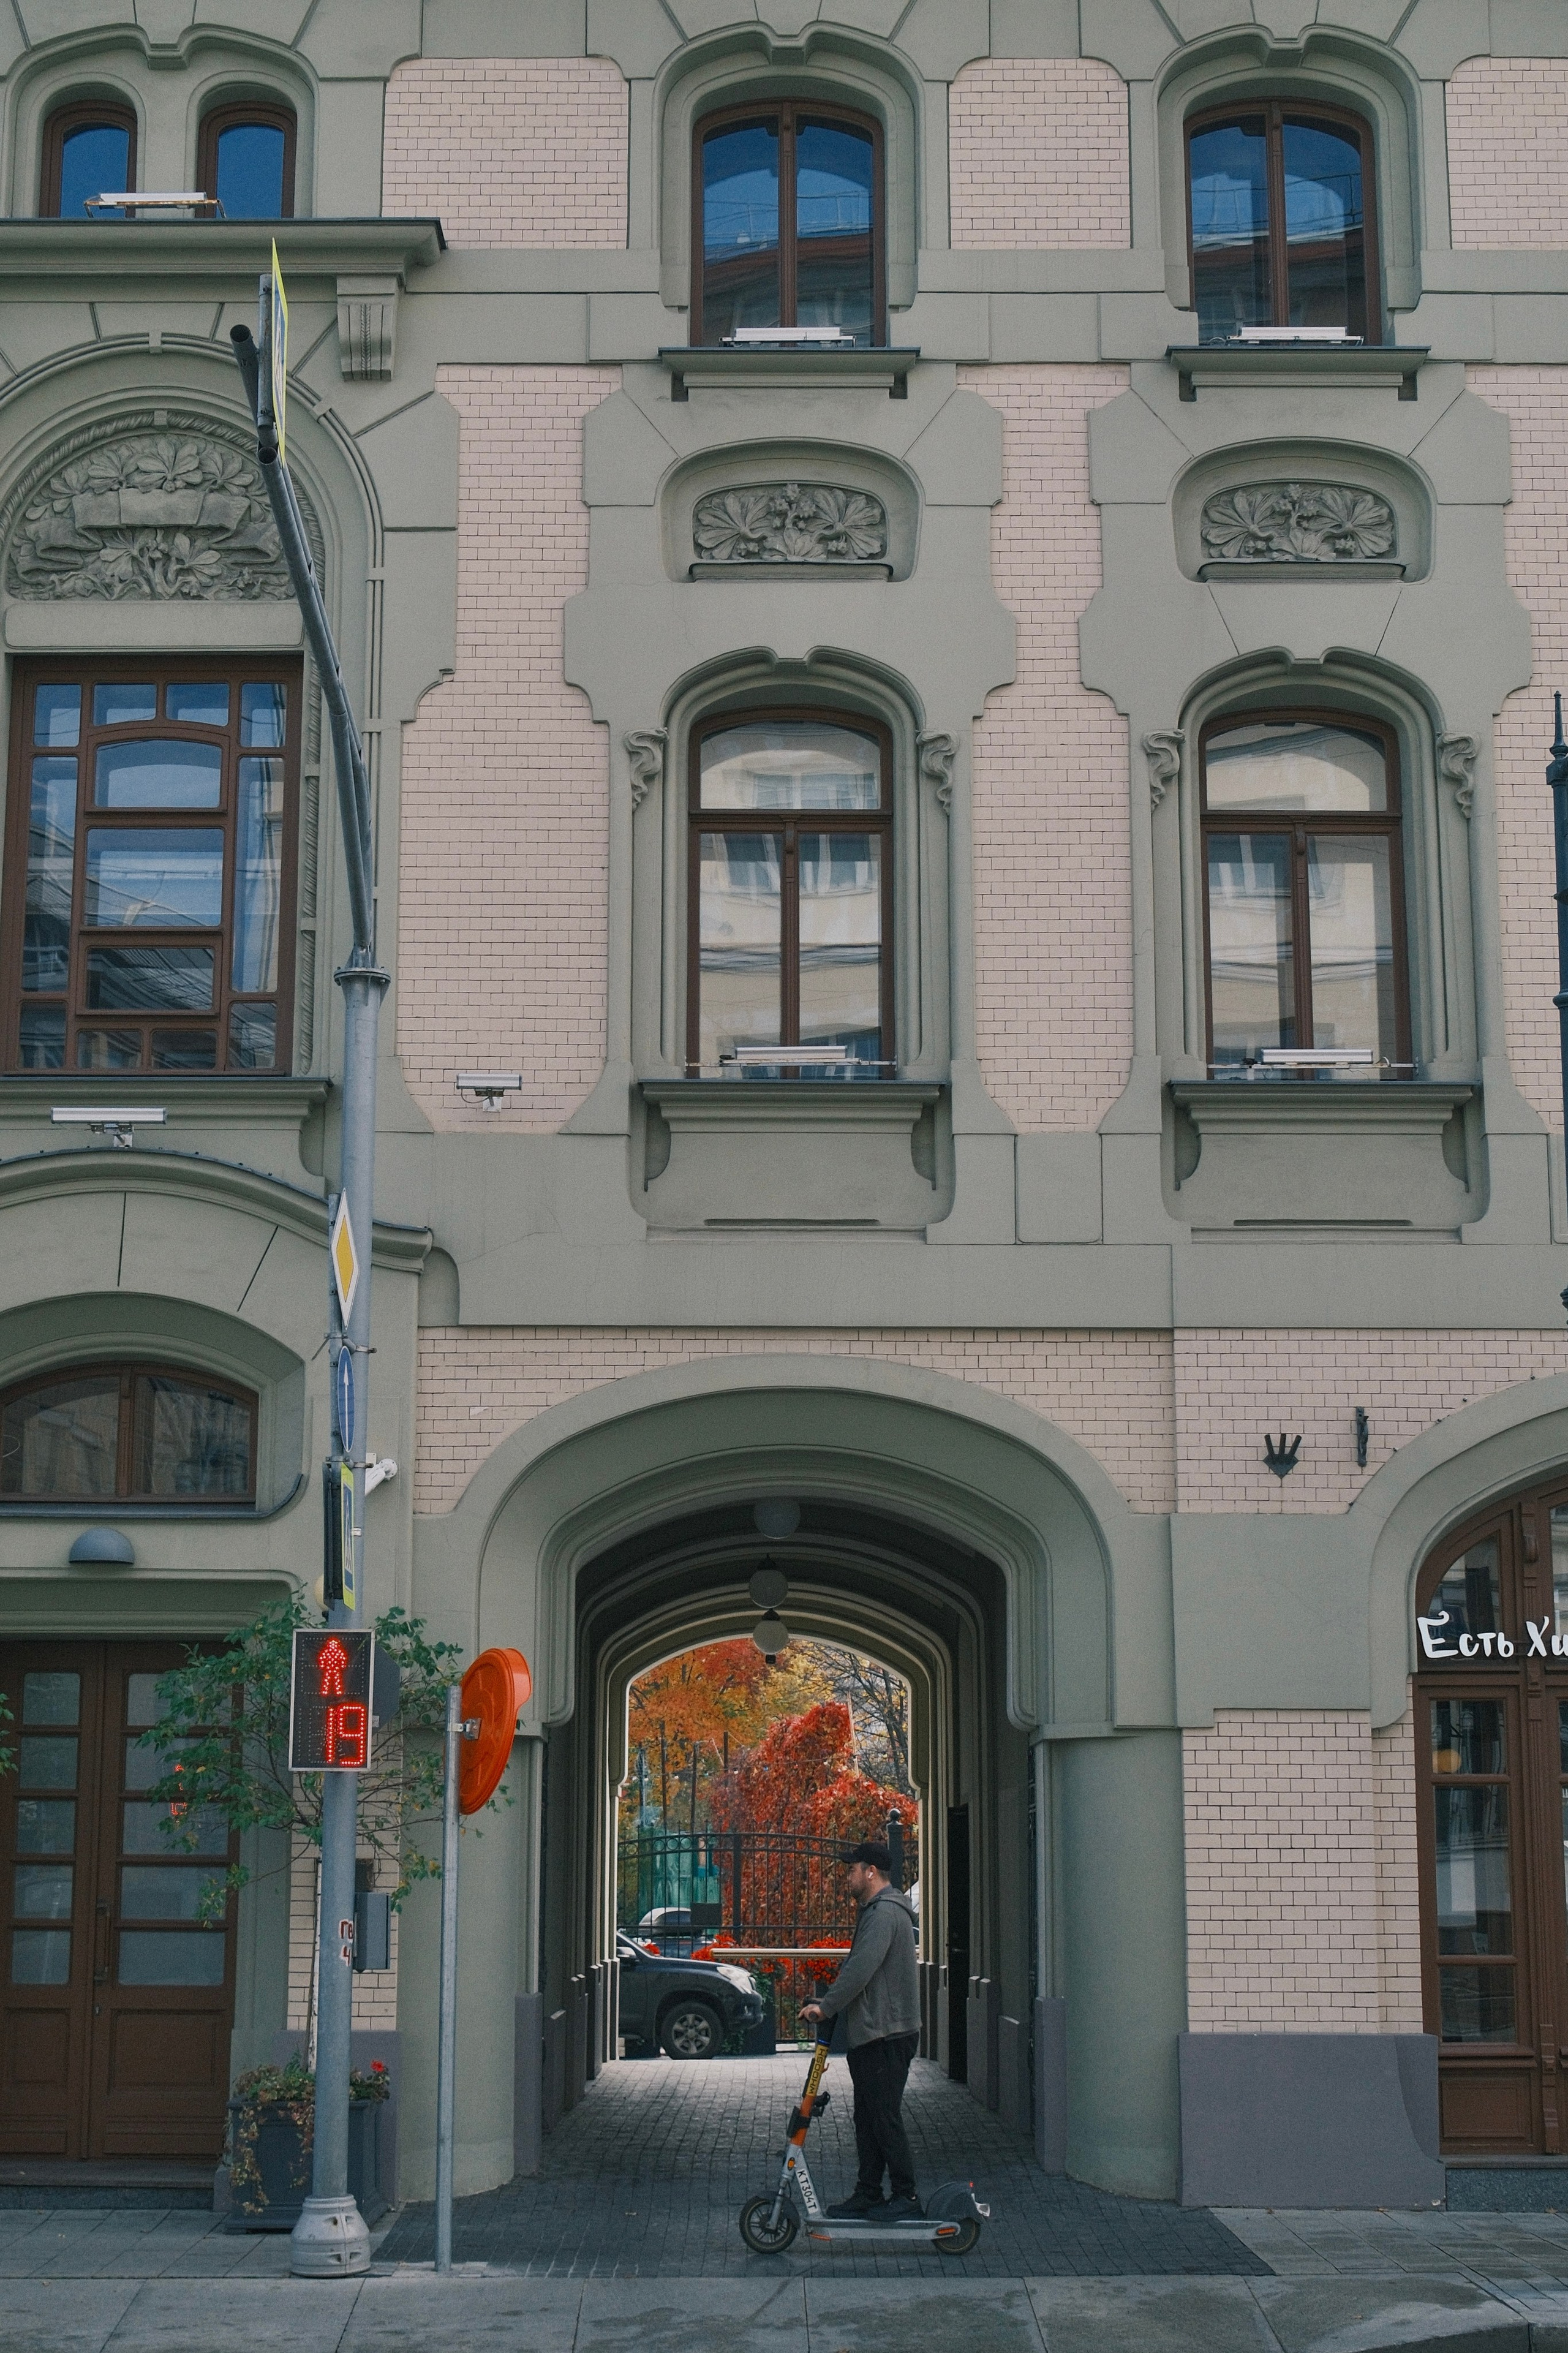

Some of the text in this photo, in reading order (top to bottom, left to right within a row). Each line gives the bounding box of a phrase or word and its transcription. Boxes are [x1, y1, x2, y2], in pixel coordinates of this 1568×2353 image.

[1417, 1610, 1514, 1659] Есть
[325, 1702, 366, 1767] 19
[809, 2048, 825, 2094] WHOOSH
